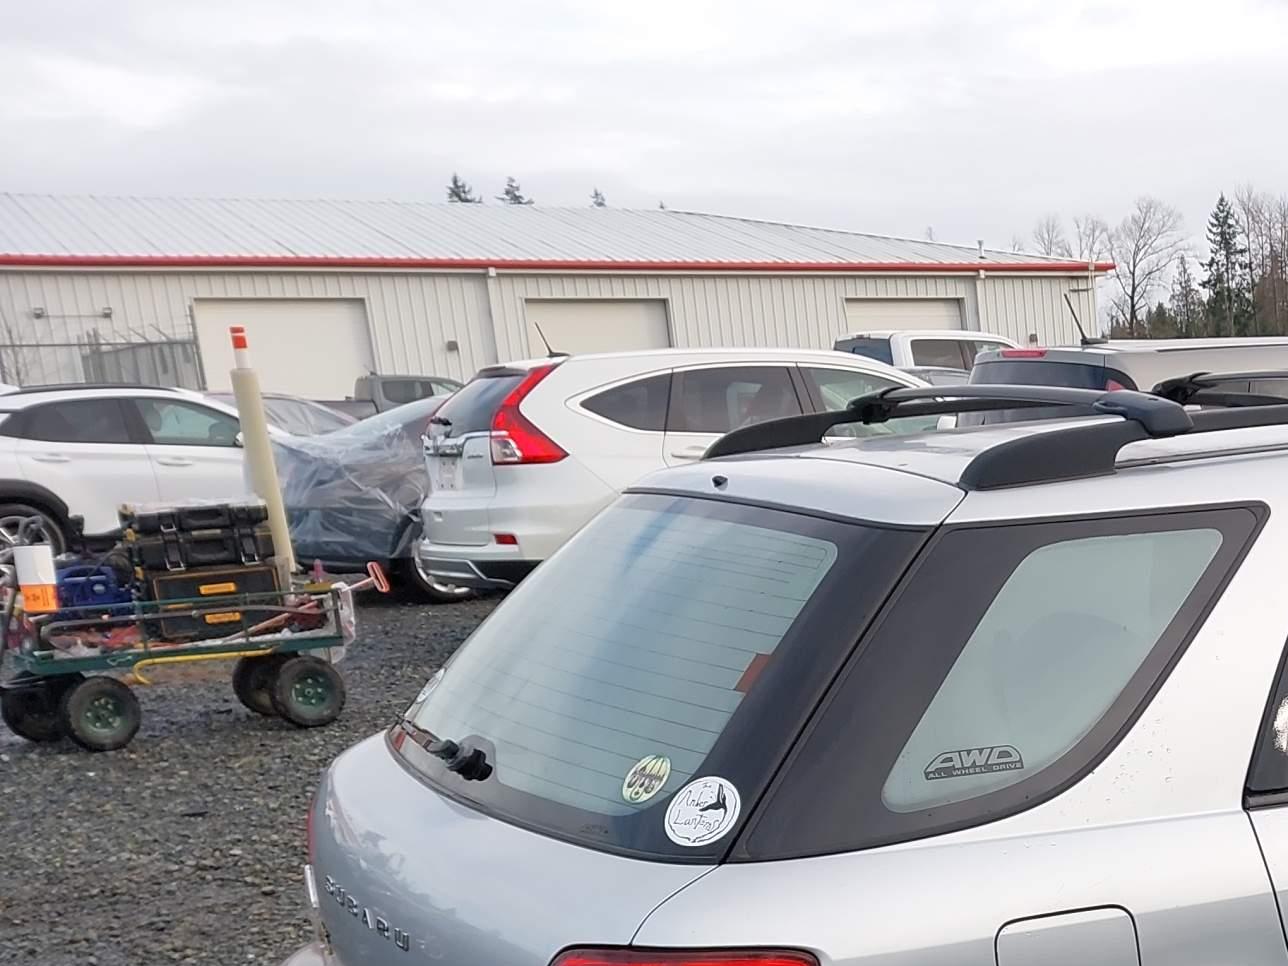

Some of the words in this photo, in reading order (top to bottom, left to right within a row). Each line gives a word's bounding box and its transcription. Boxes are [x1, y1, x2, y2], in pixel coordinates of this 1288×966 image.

[926, 747, 1021, 772] AWD
[927, 771, 948, 780] ALL
[952, 766, 988, 776] WHEEL
[992, 761, 1022, 771] DRIVE
[324, 874, 410, 952] SUBARU
